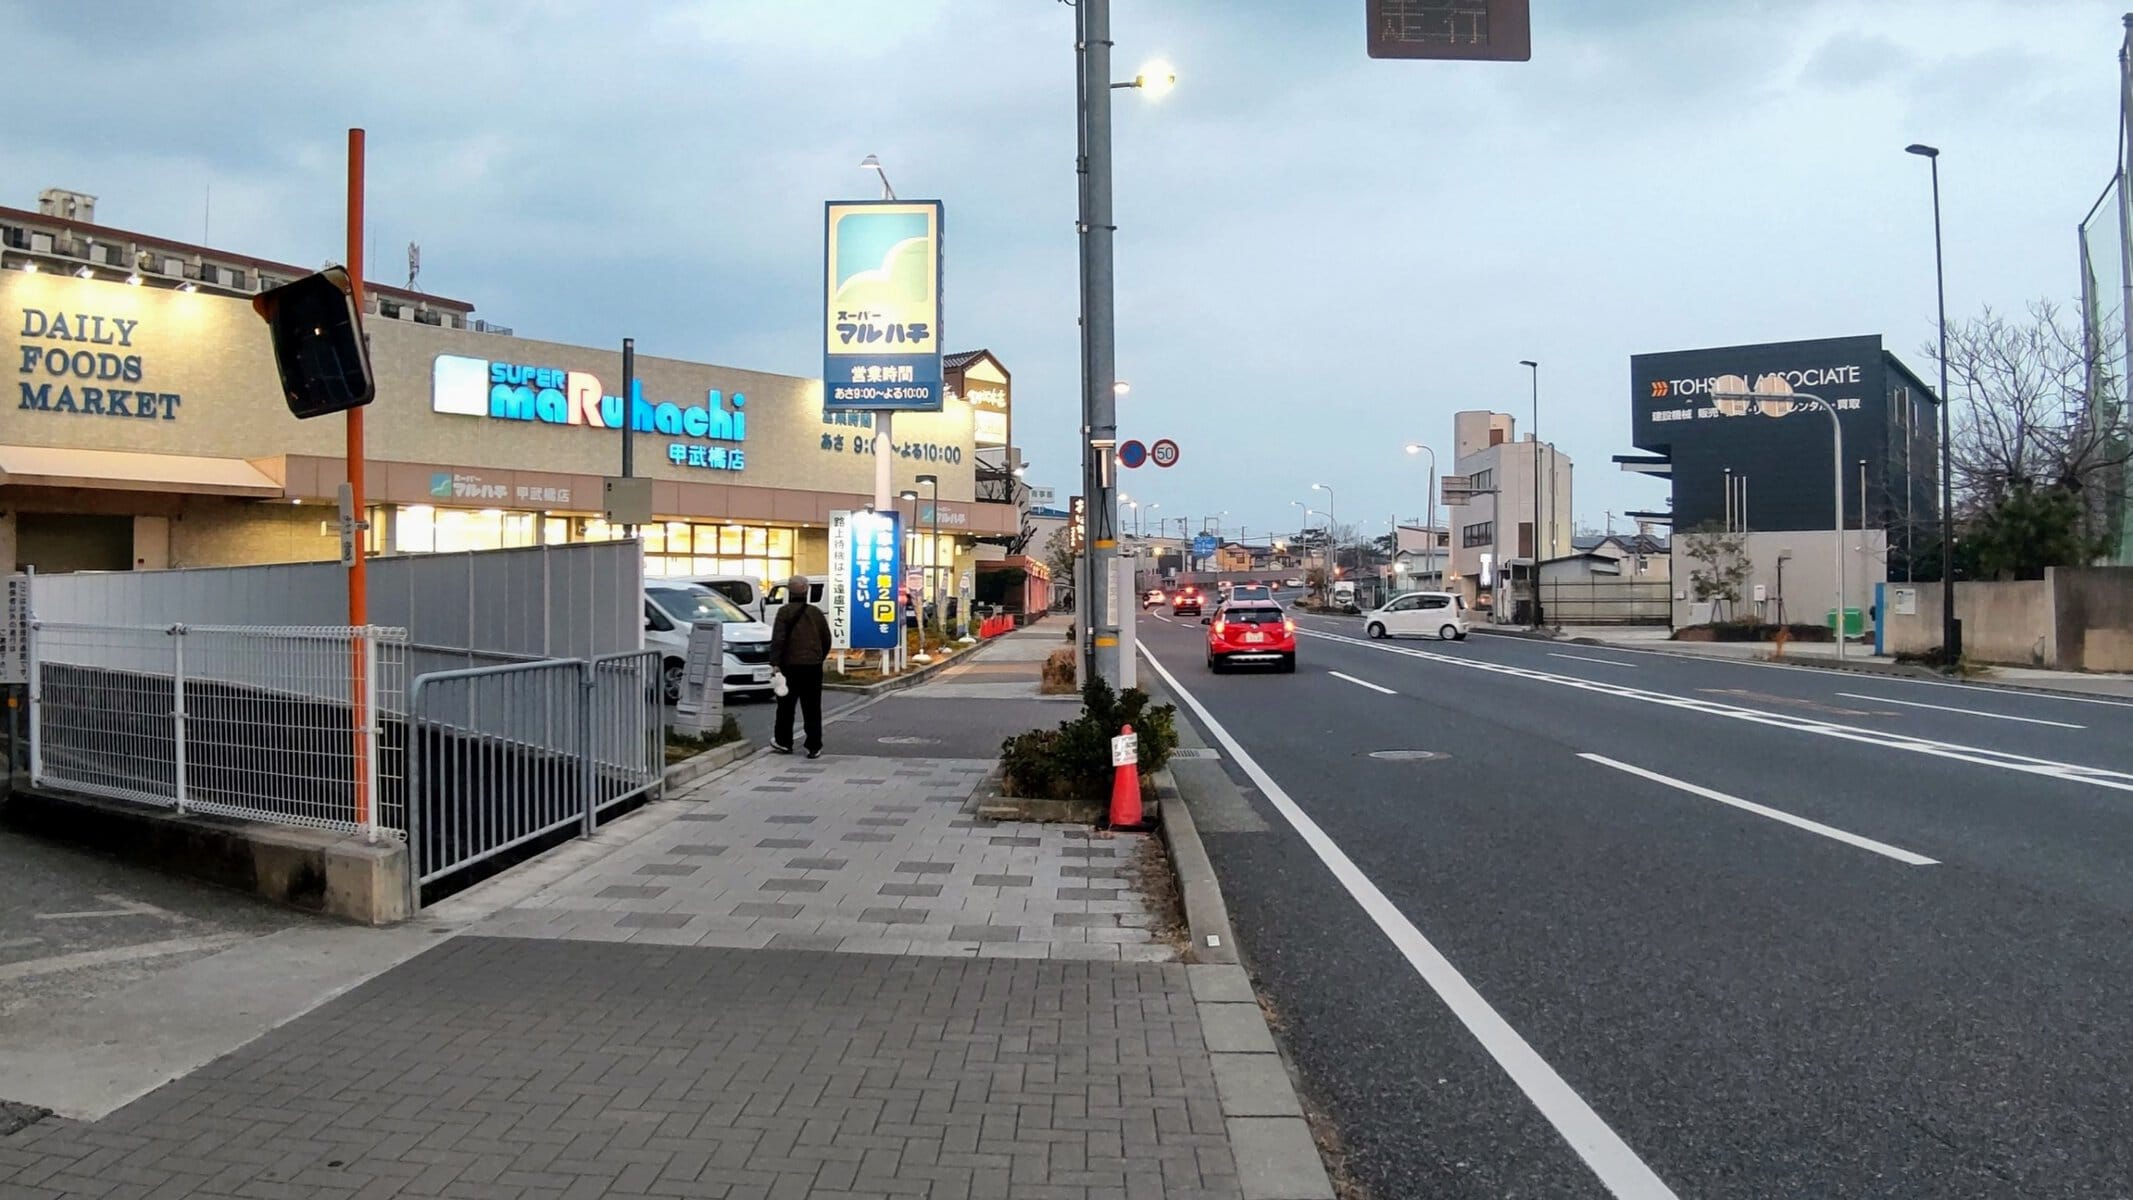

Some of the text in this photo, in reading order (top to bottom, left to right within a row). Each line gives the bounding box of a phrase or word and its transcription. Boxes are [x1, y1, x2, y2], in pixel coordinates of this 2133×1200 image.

[21, 308, 138, 346] DAILY
[838, 311, 881, 320] スーパー
[836, 323, 929, 344] マルハチ
[19, 345, 142, 383] FOODS
[490, 362, 566, 389] SUPER
[851, 365, 913, 383] 営業時間
[18, 382, 182, 420] MARKET
[669, 443, 745, 471] 甲武橋店
[1157, 447, 1174, 460] 50
